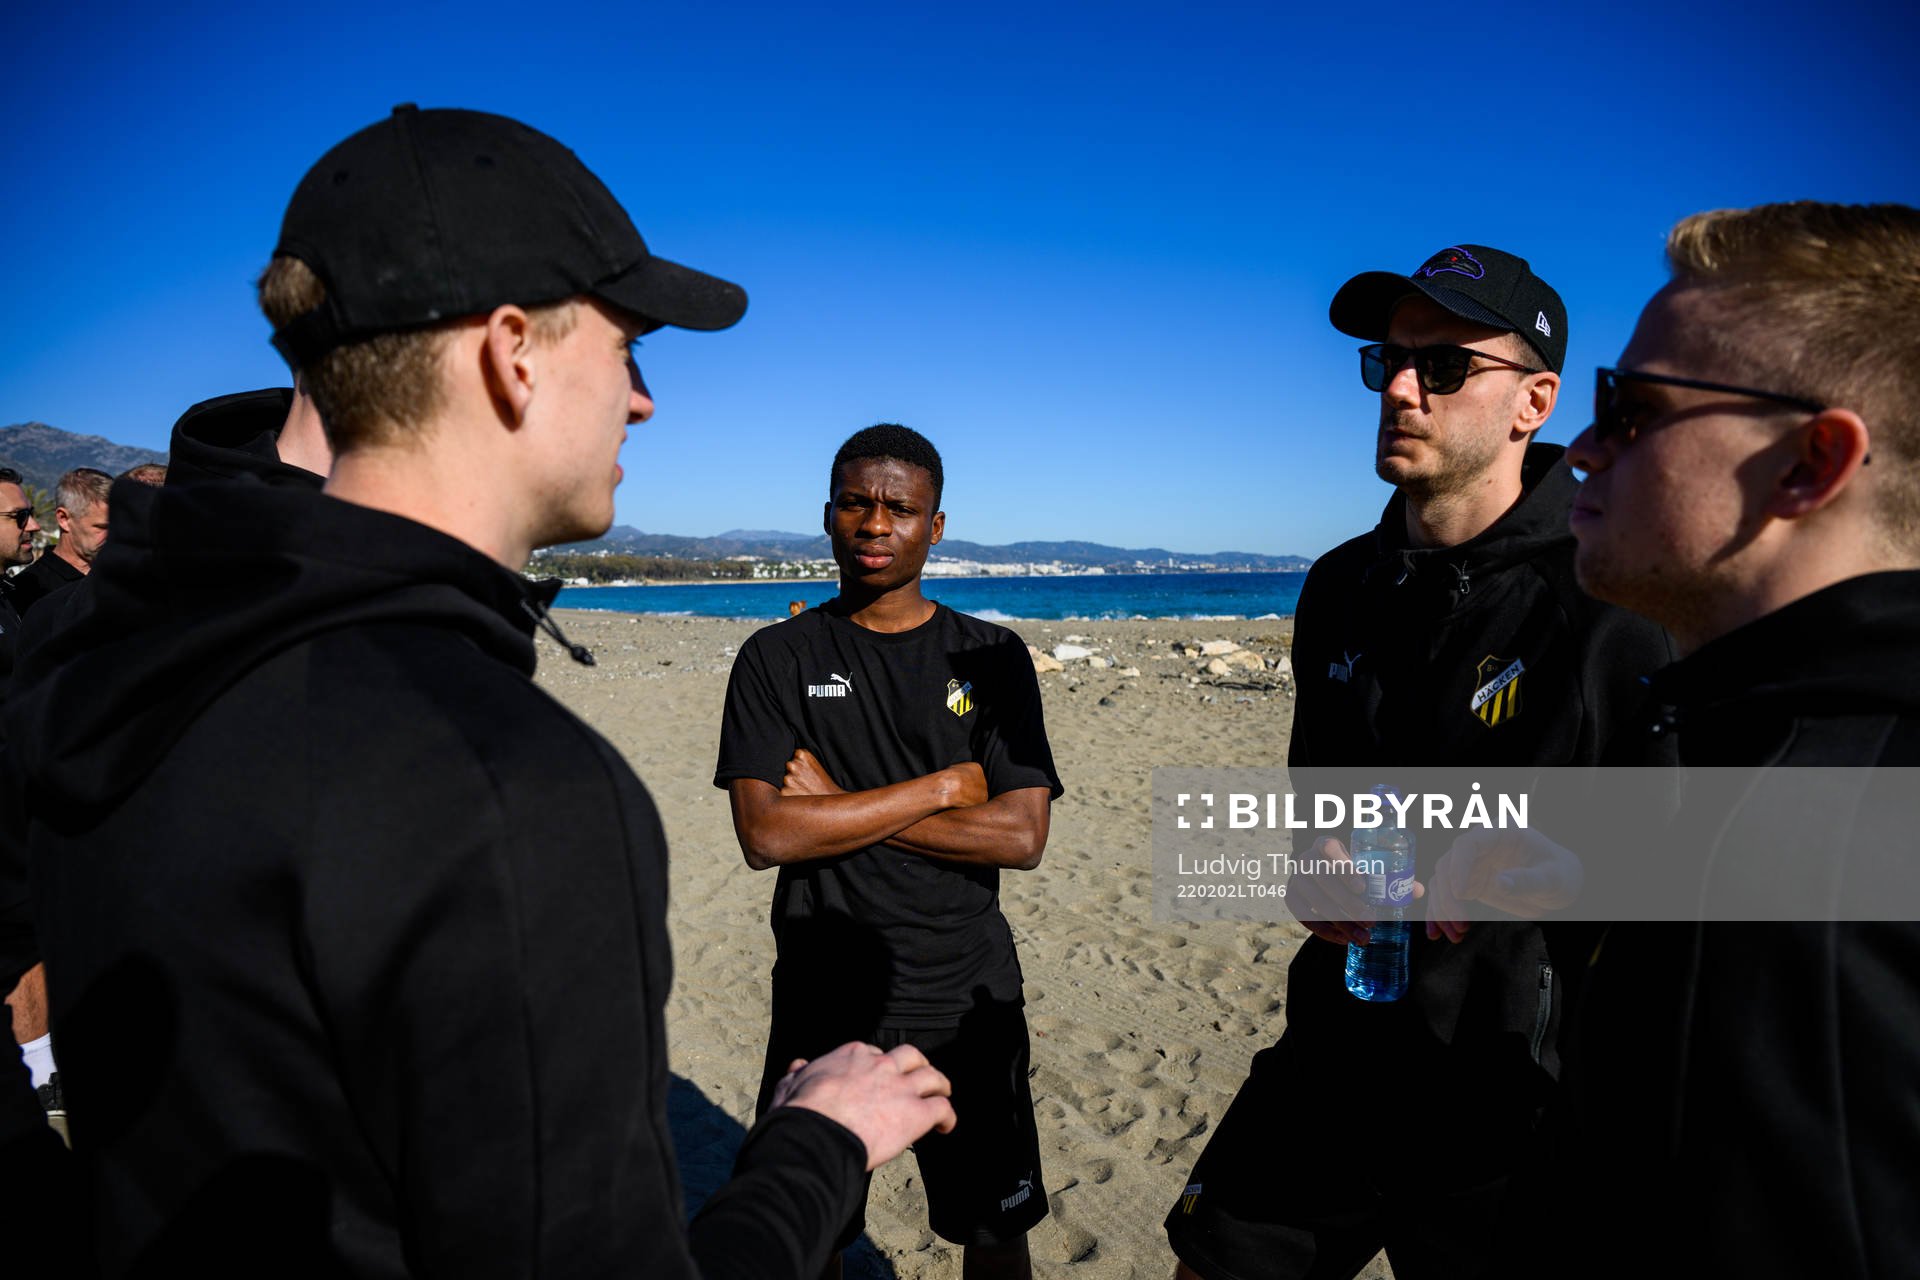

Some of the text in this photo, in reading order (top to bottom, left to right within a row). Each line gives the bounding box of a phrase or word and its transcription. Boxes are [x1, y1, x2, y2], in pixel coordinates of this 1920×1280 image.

[808, 684, 846, 698] PUMA
[1477, 663, 1520, 703] HÄCKEN
[1001, 1187, 1030, 1211] PUMA
